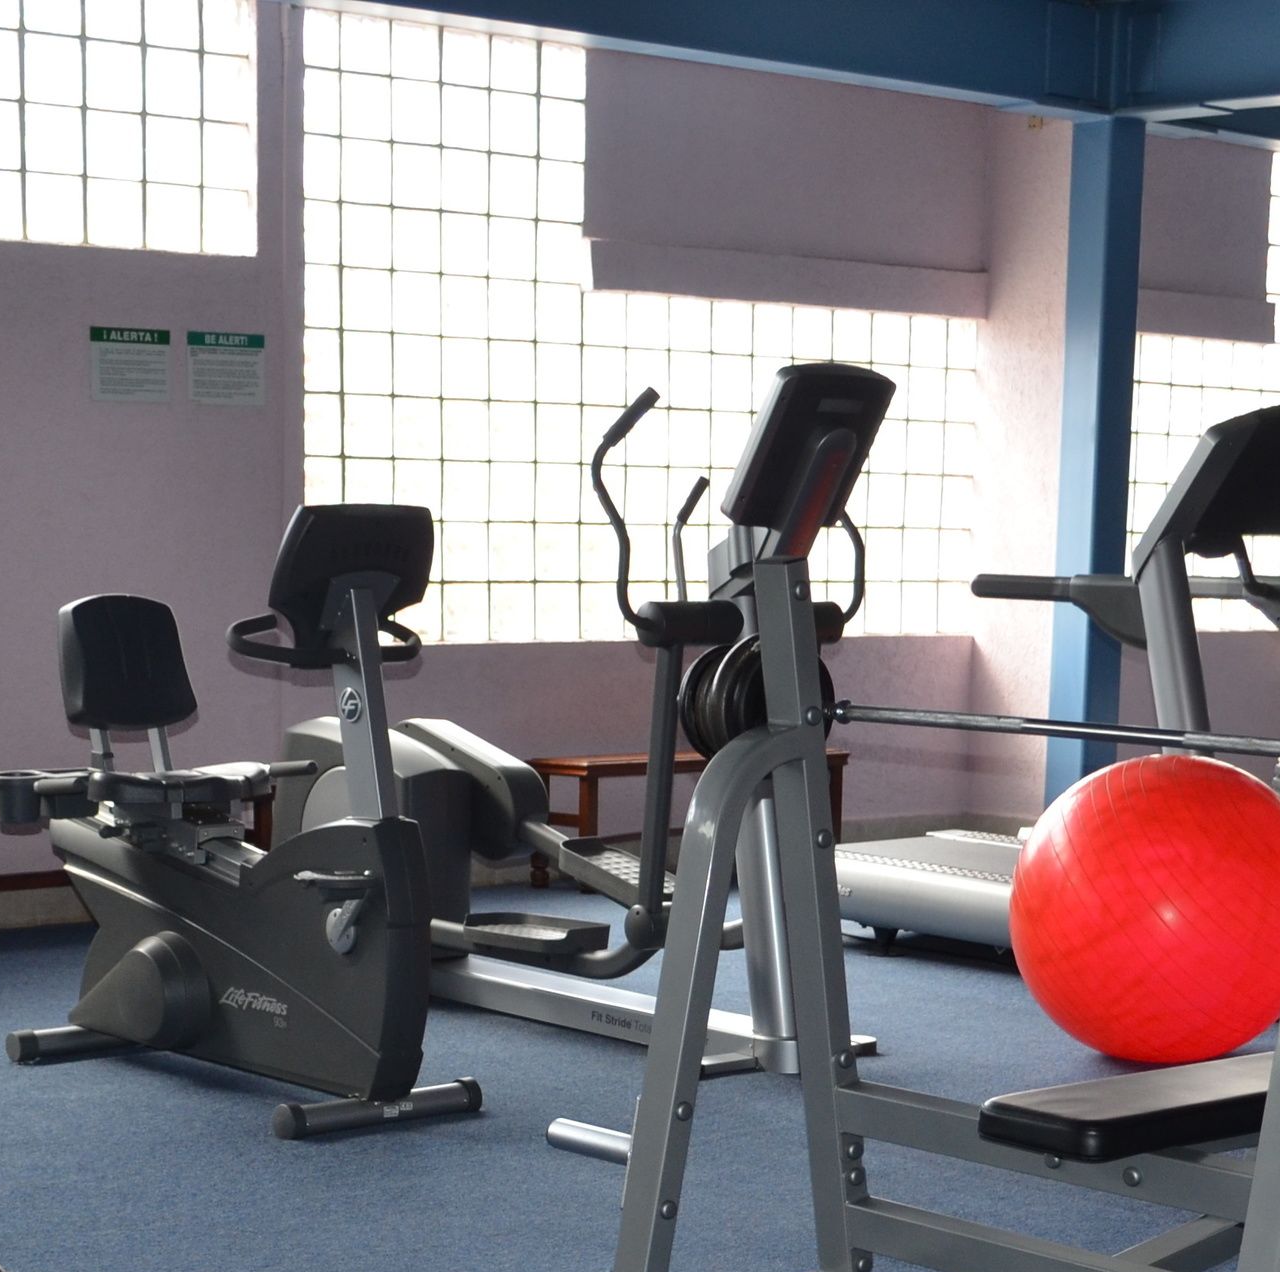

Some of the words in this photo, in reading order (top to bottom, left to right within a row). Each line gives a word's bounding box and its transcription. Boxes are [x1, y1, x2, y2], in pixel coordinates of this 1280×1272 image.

[109, 331, 152, 342] ALERTA
[205, 334, 217, 344] BE
[219, 335, 248, 346] ALERT!
[591, 1010, 603, 1022] Fit
[605, 1014, 632, 1030] Stride
[635, 1020, 653, 1034] Tota
